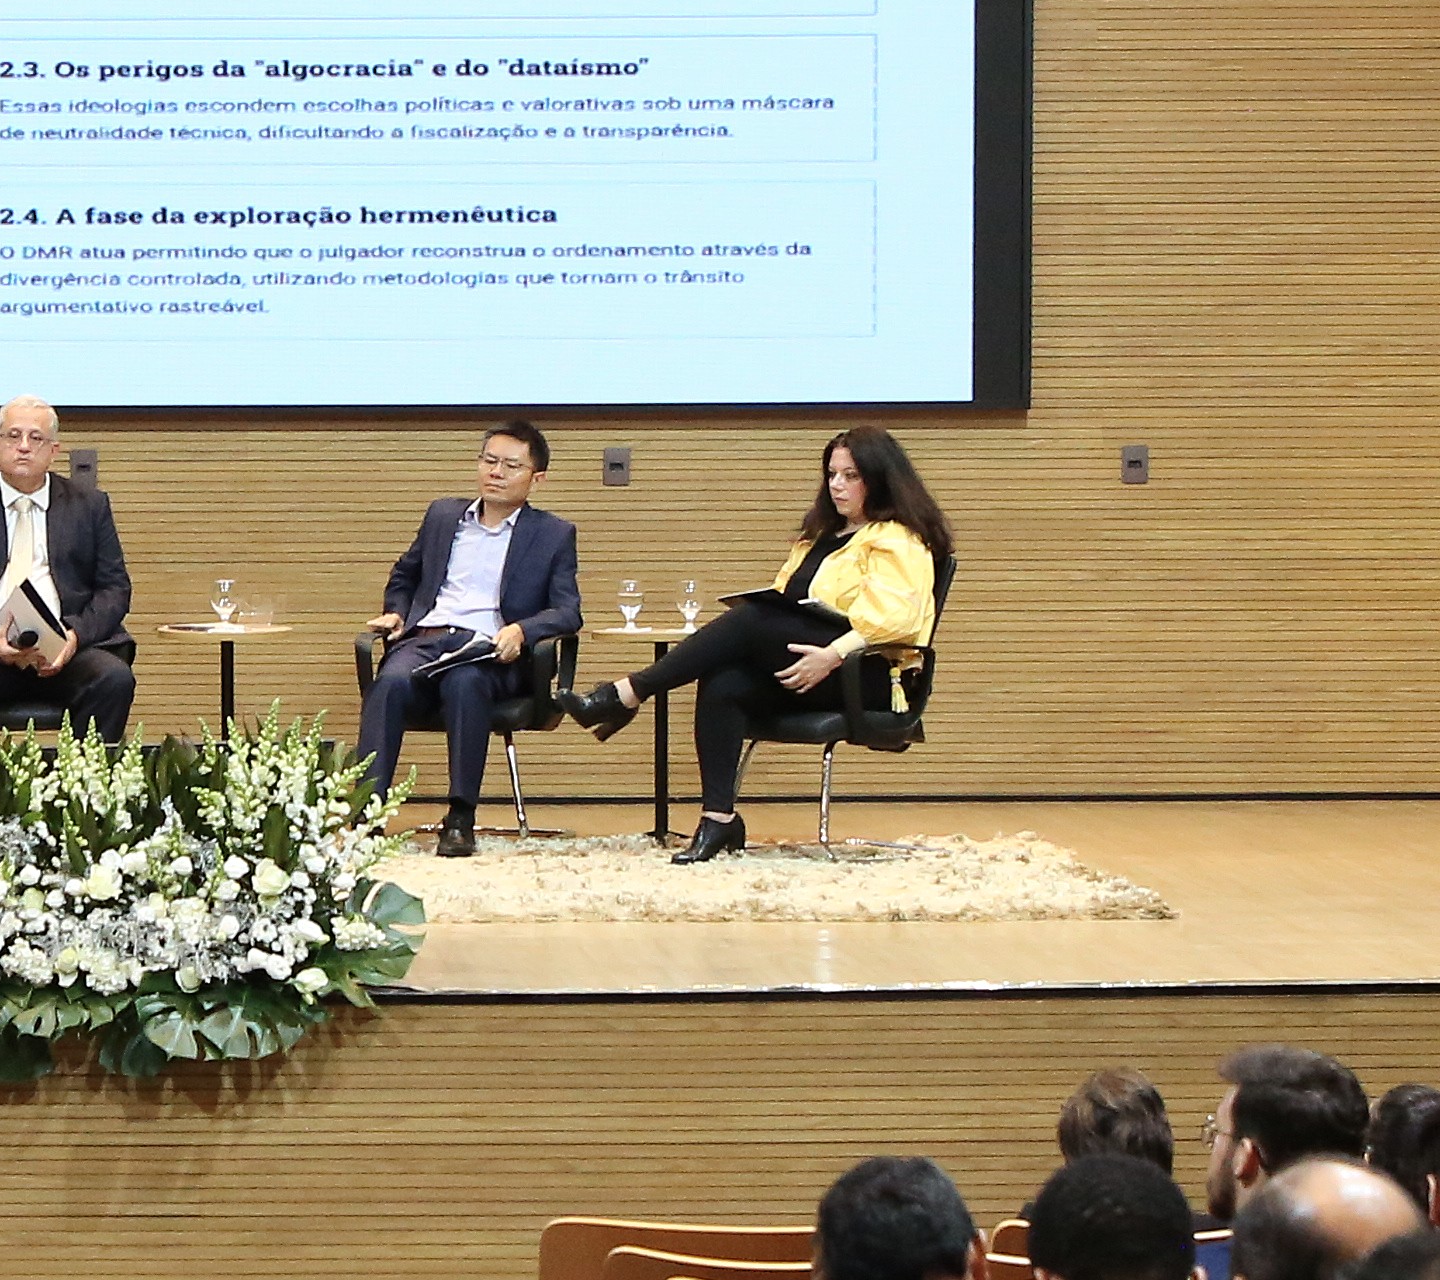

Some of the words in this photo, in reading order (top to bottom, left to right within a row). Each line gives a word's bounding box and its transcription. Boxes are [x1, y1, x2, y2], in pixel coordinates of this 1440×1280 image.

[0, 62, 44, 78] 2.3.
[55, 61, 89, 77] Os
[99, 60, 203, 82] perigos
[213, 60, 245, 78] da
[433, 64, 446, 77] e
[456, 59, 488, 76] do
[0, 208, 45, 225] 2.4.
[57, 208, 75, 225] A
[86, 207, 143, 224] fase
[152, 207, 184, 224] da
[194, 207, 351, 228] exploração
[361, 206, 556, 224] hermenêutica
